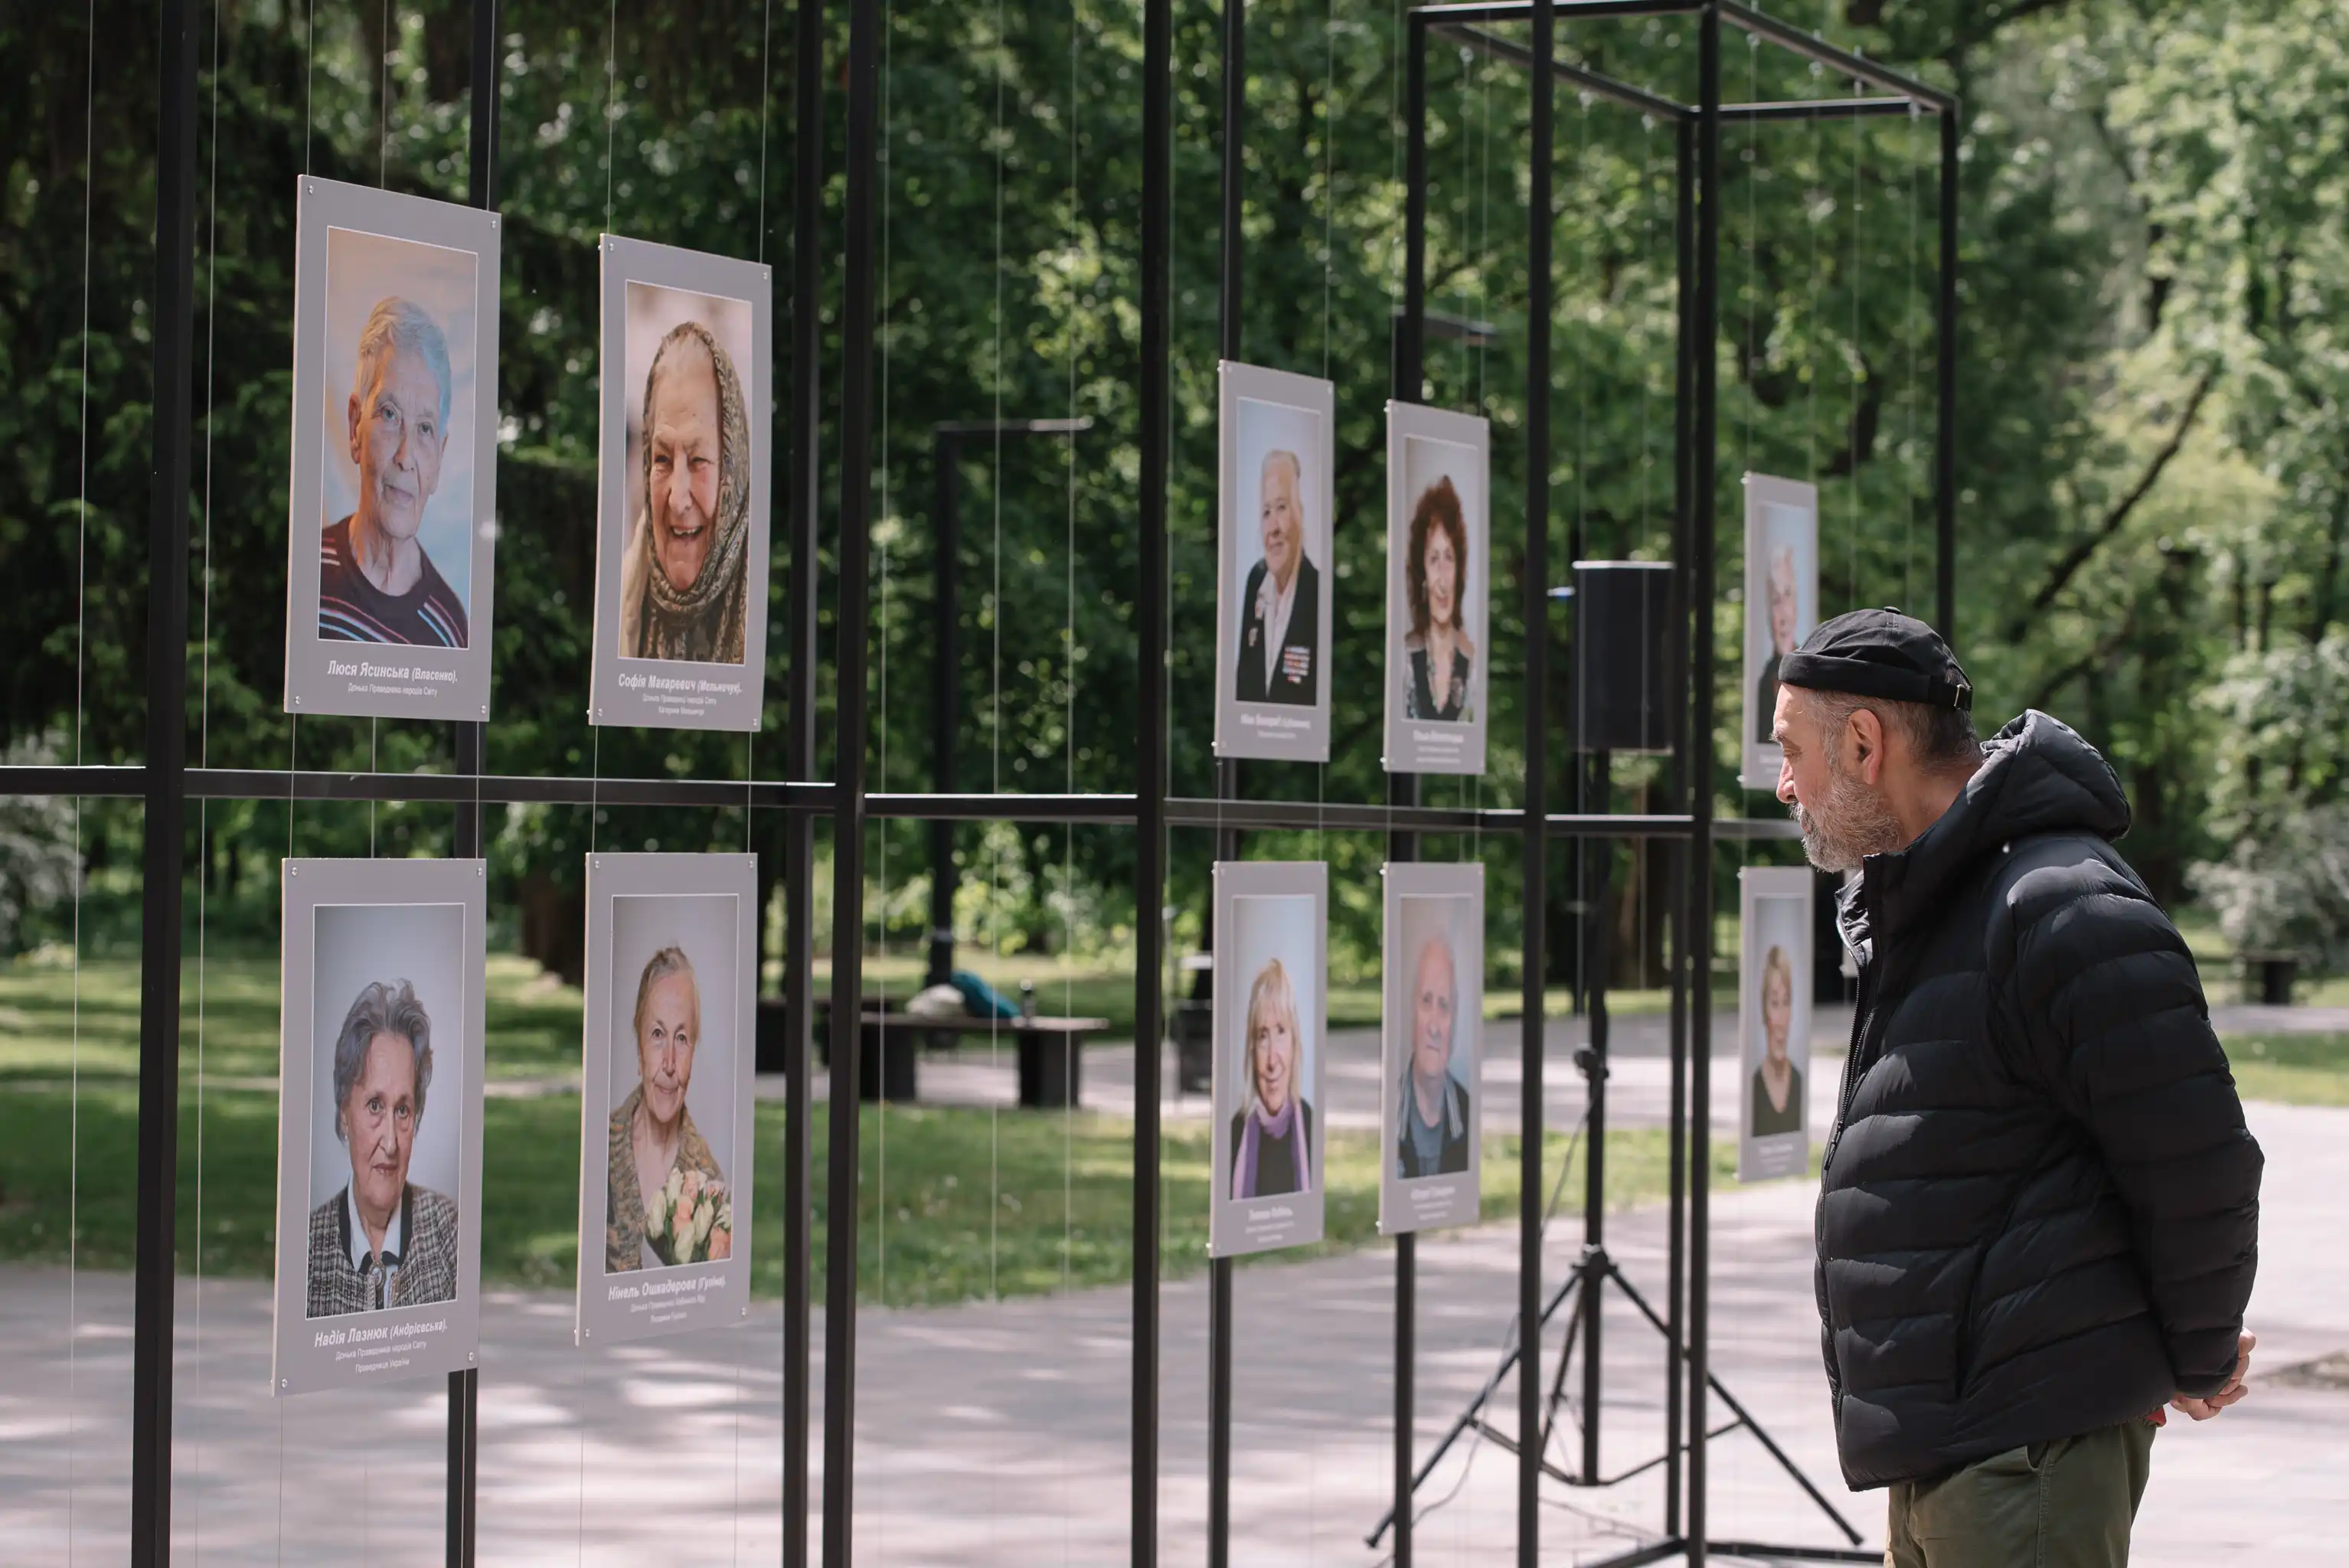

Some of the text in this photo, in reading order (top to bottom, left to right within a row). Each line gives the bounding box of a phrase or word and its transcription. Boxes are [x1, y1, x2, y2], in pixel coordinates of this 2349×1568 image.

[327, 660, 358, 676] Люся
[360, 662, 409, 679] Ясинська
[619, 673, 645, 690] Софія
[648, 675, 696, 693] Макаревич
[608, 1285, 639, 1301] Нінель
[314, 1329, 345, 1348] Надія
[348, 1326, 389, 1344] Лазнюк
